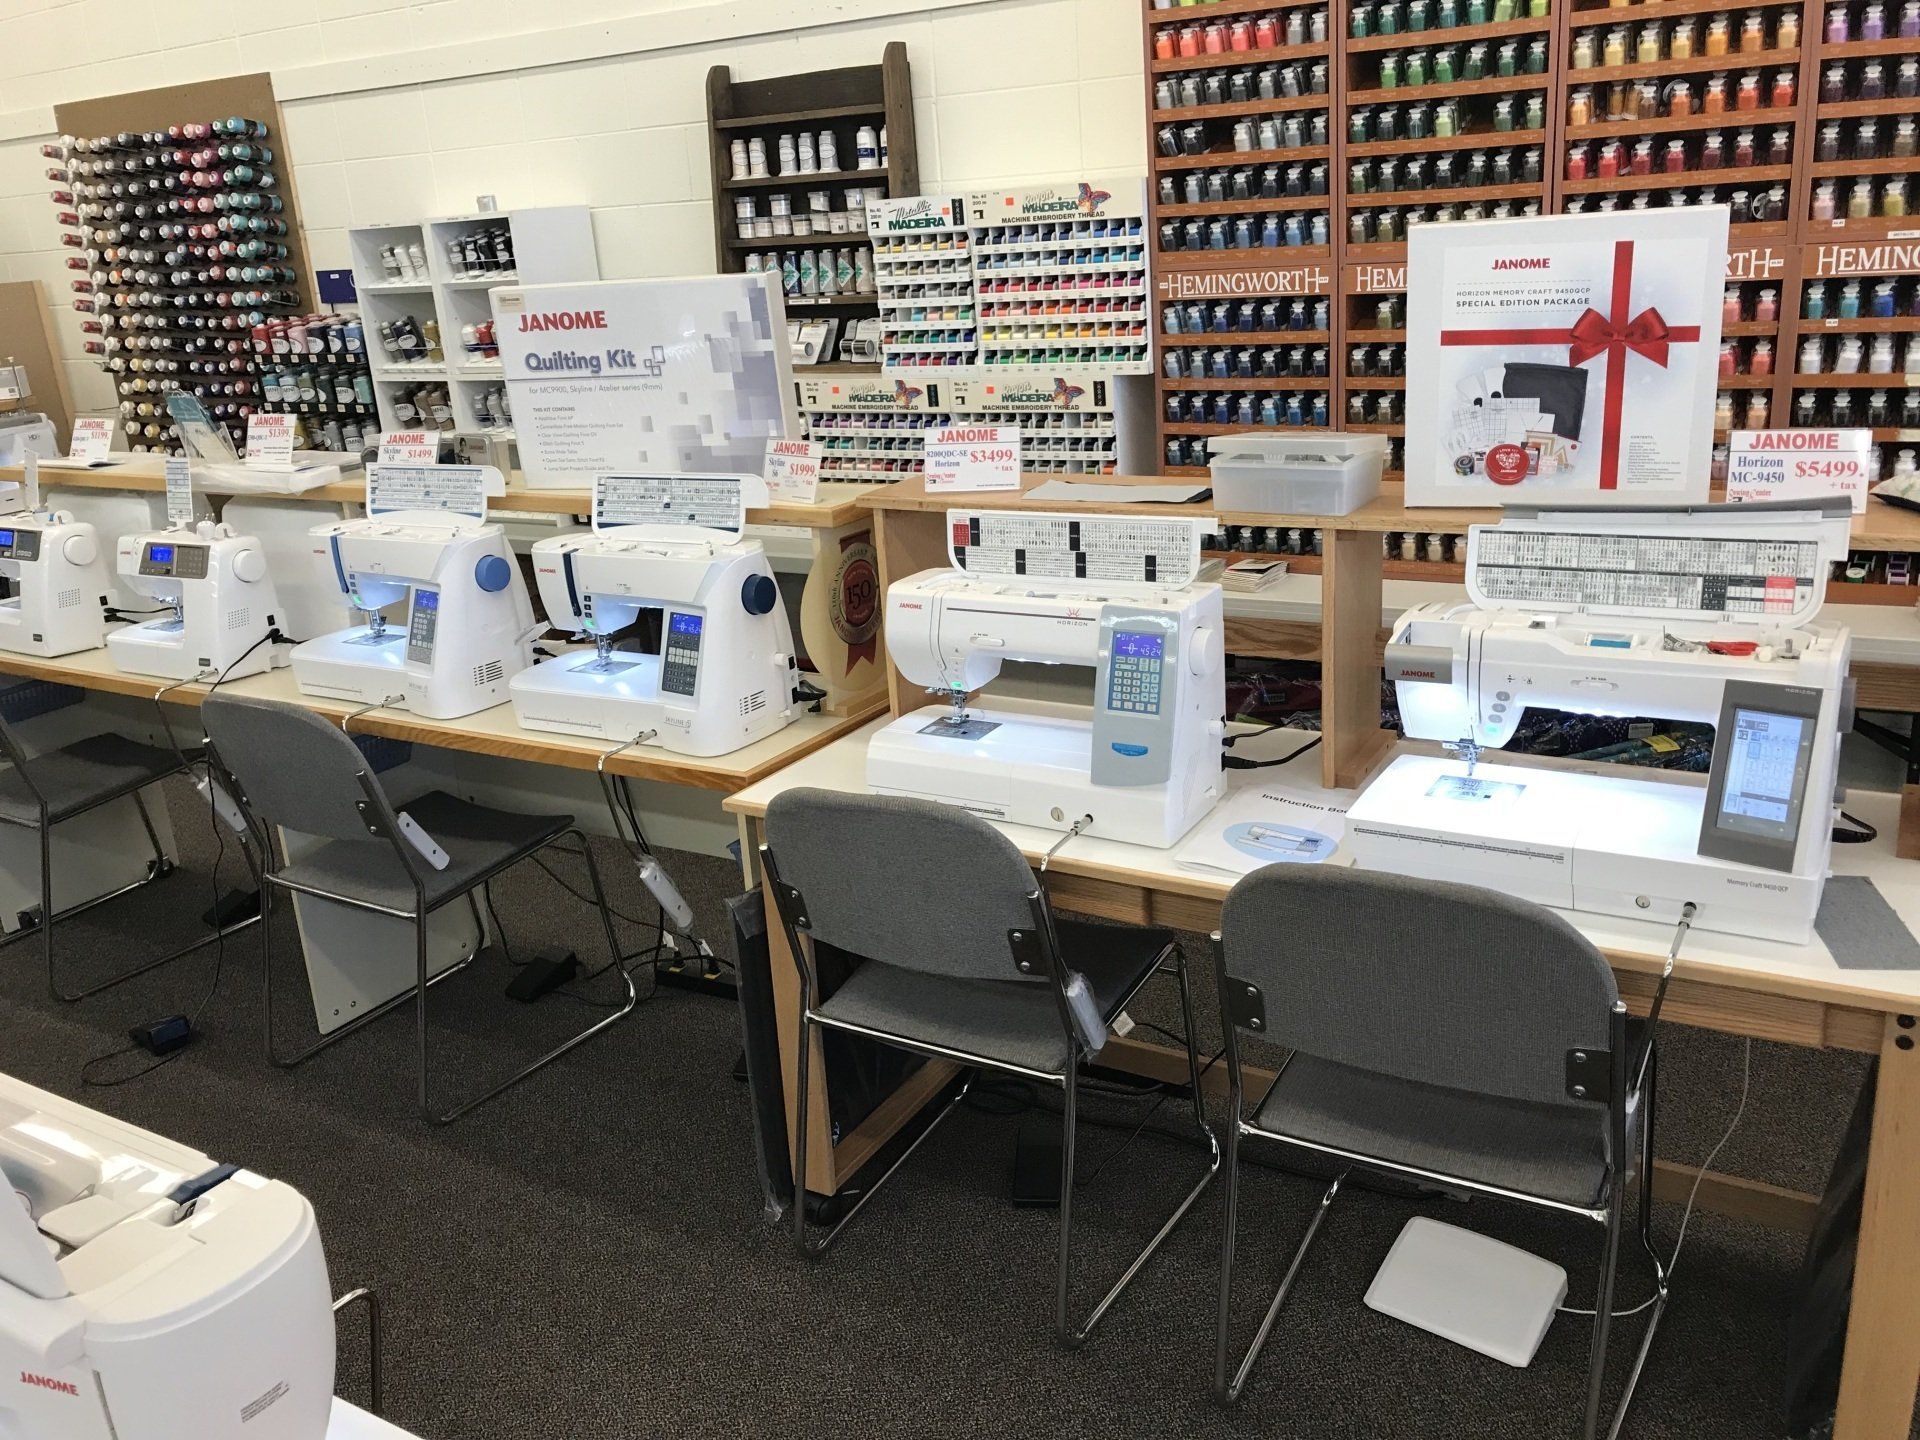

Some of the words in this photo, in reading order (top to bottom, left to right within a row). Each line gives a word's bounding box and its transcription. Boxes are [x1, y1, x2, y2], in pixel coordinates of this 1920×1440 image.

[1022, 199, 1079, 214] MADEIRA
[888, 214, 946, 230] MADEIRA
[1001, 216, 1030, 224] MACHINE
[1032, 213, 1076, 222] EMBROIDERY
[1078, 210, 1105, 218] THREAD
[1492, 258, 1550, 270] JANOME
[1168, 268, 1320, 298] HEMINGWORTH
[1500, 298, 1540, 306] EDITION
[1544, 298, 1590, 306] PACKAGE
[518, 310, 608, 332] JANOME
[525, 350, 602, 374] Quilting
[606, 349, 637, 368] Kit
[540, 386, 568, 394] MC9900,
[570, 385, 592, 394] Skyline
[599, 384, 620, 392] Atelier
[642, 383, 663, 392] (9mm)
[848, 391, 896, 403] MADEIRA
[1002, 390, 1055, 402] MADEIRA
[80, 420, 105, 429] JANOME
[254, 416, 284, 426] JANOME
[386, 434, 425, 444] JANOME
[937, 428, 998, 442] JANOME
[1749, 433, 1839, 450] JANOME
[384, 446, 402, 455] Skyline
[408, 448, 434, 459] $1499.
[774, 442, 810, 456] JANOME
[926, 450, 968, 458] 8200QDC-SE
[970, 450, 1016, 464] $3499.
[768, 457, 785, 468] Skyline
[790, 462, 816, 478] $1999.
[1738, 456, 1784, 468] Horizon
[1794, 460, 1864, 478] $5499.
[1730, 472, 1784, 484] MC-9450
[846, 580, 871, 610] 150
[1400, 670, 1435, 678] JANOME
[1262, 793, 1324, 811] Instruction
[1727, 878, 1748, 888] Memory
[1750, 880, 1762, 888] Craft
[20, 1371, 80, 1396] JANOME
